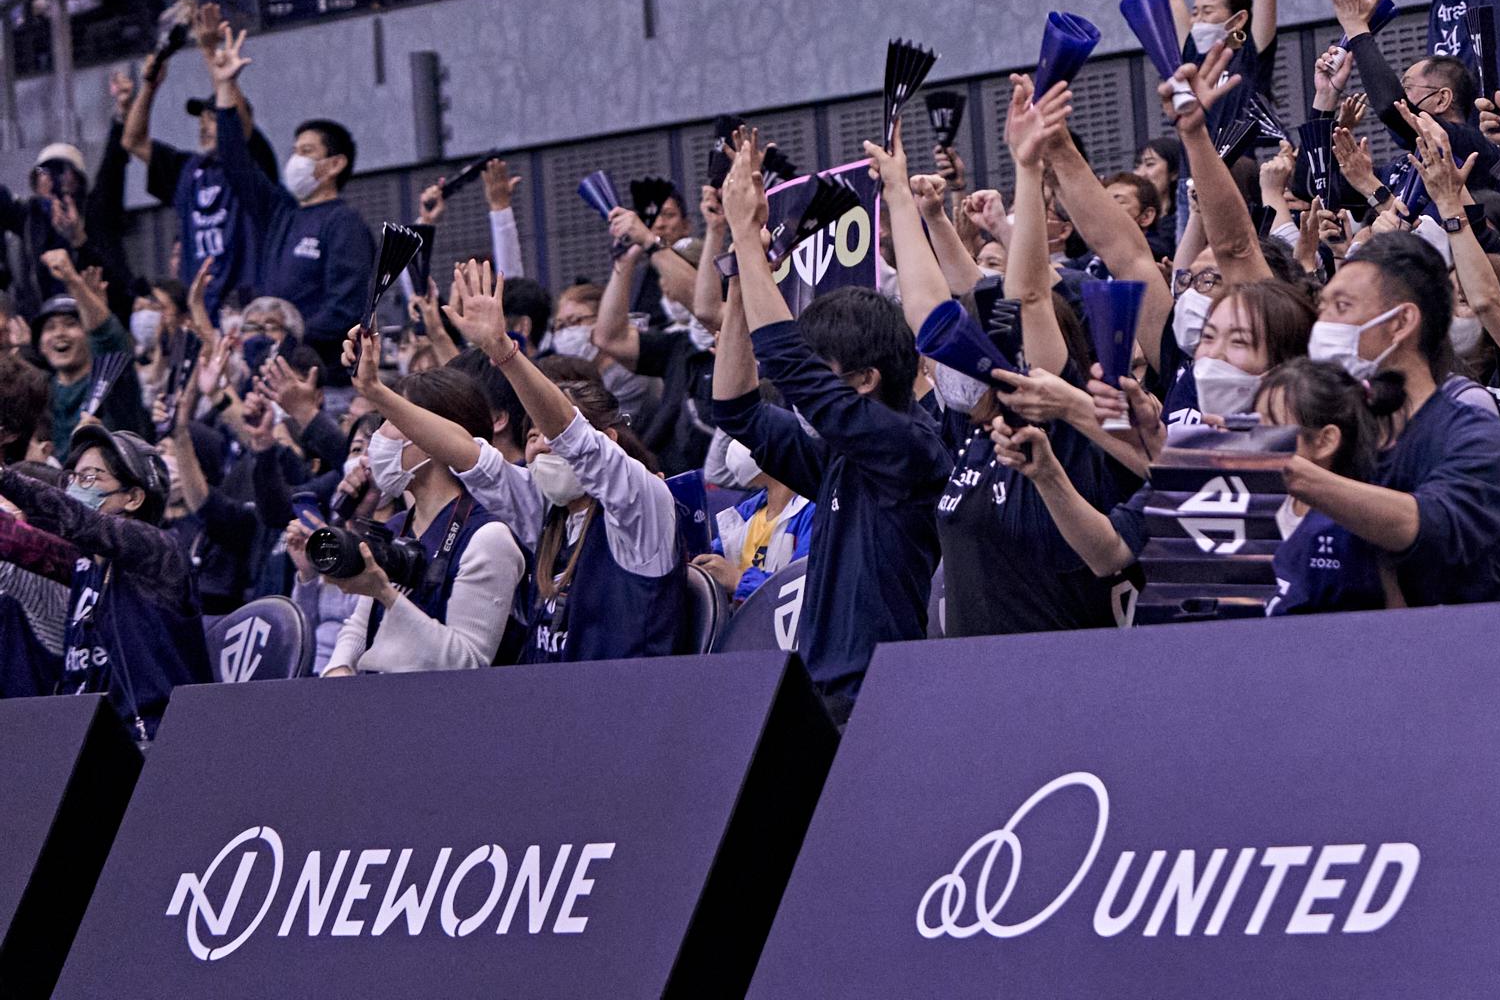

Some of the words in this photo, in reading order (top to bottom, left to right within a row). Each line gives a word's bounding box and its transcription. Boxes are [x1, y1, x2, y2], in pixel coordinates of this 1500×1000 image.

[444, 532, 457, 552] EOS
[1309, 558, 1341, 570] ZOZO
[277, 842, 617, 939] NEWONE
[1092, 842, 1421, 938] UNITED
